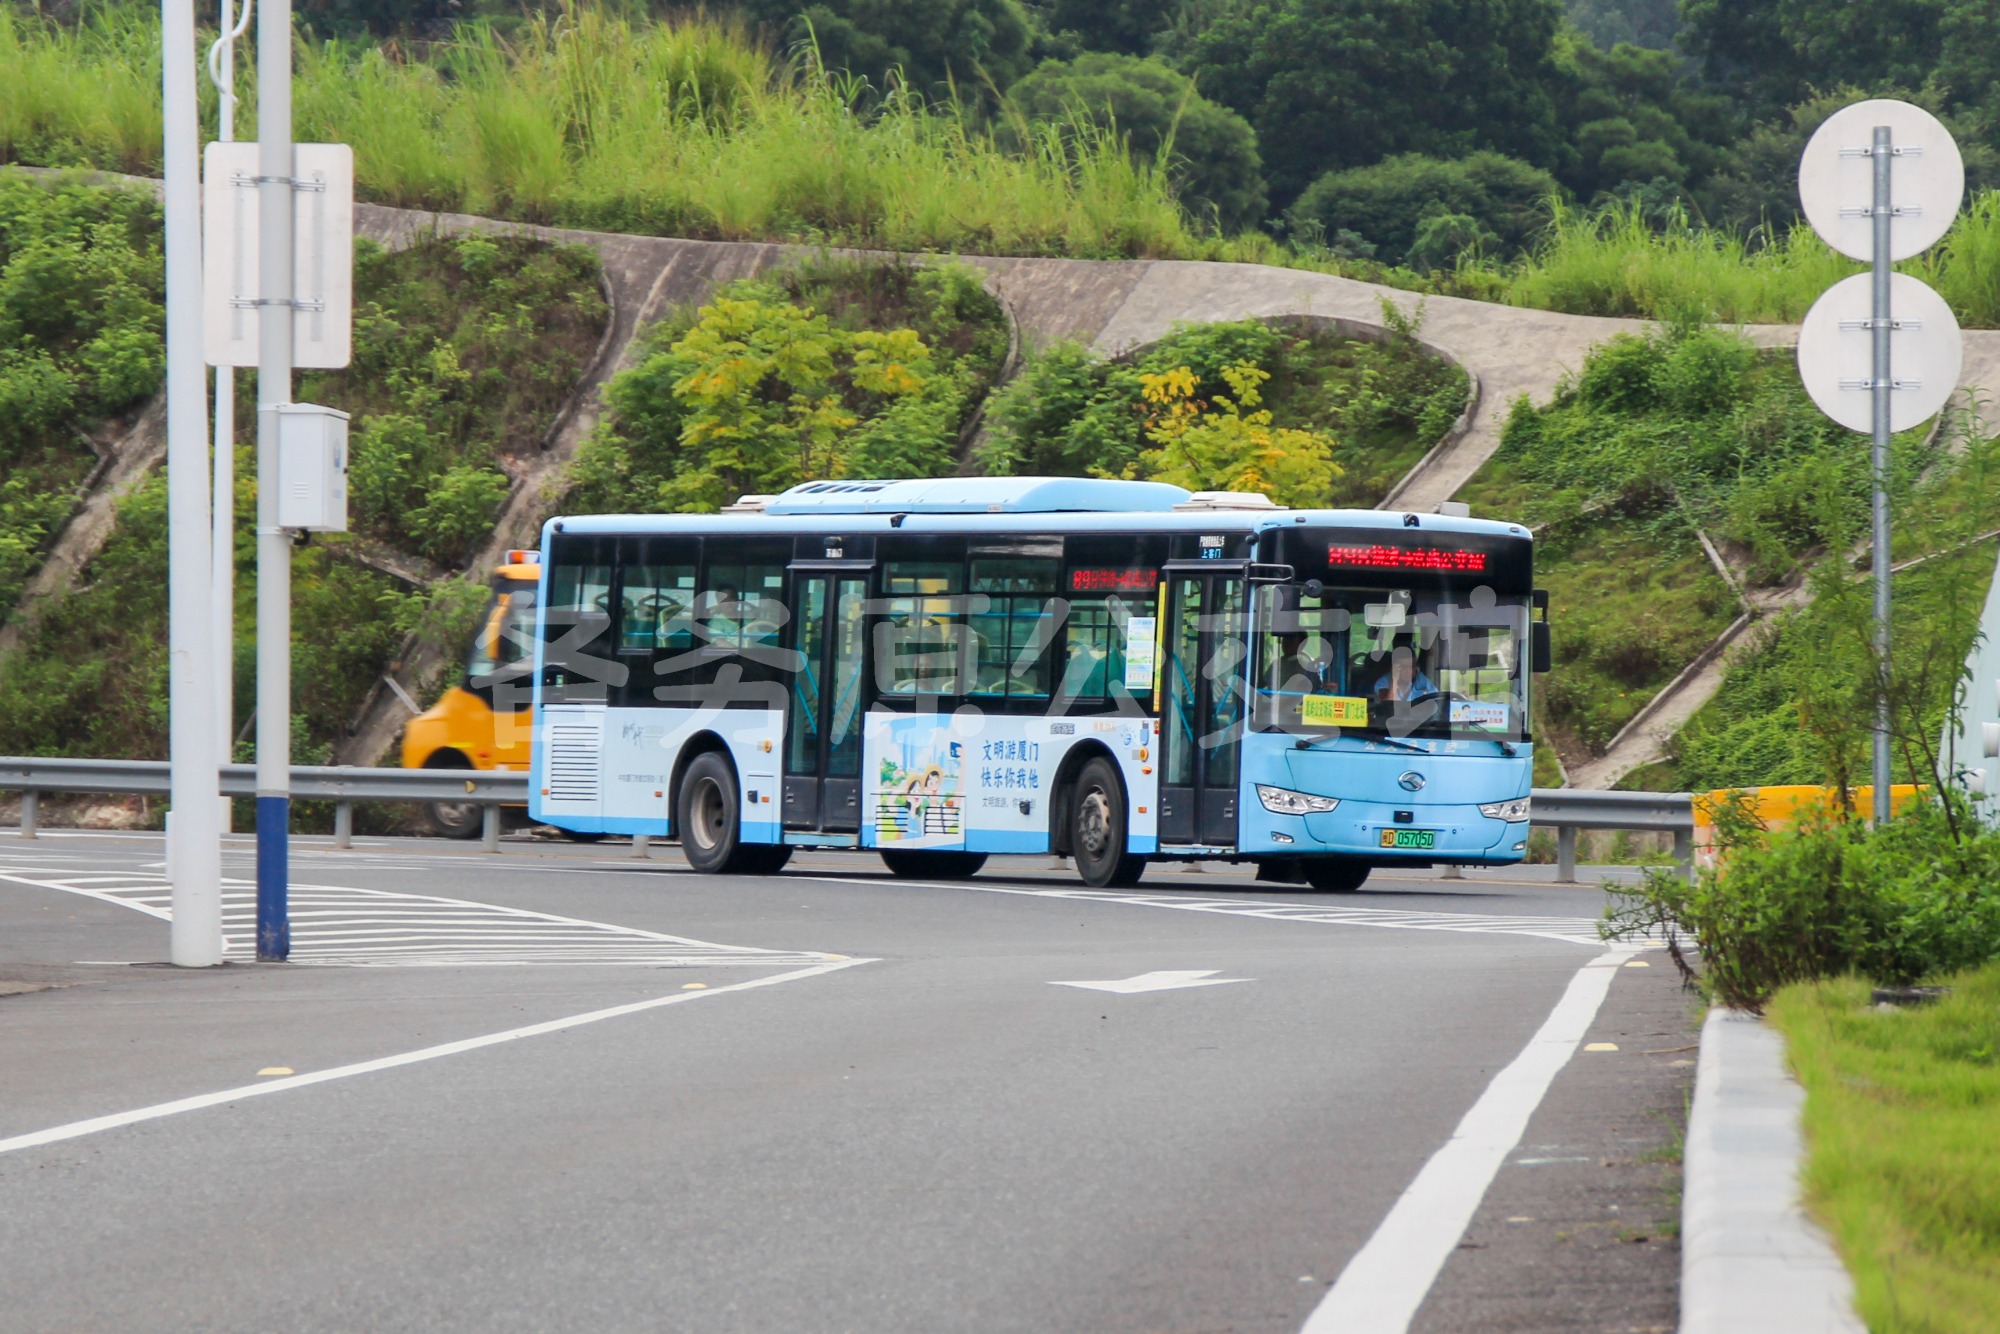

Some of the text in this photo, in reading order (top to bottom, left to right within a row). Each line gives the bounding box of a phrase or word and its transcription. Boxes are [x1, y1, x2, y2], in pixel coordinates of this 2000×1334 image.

[982, 739, 1039, 762] 文明游厦门
[981, 766, 1039, 789] 快乐你我他
